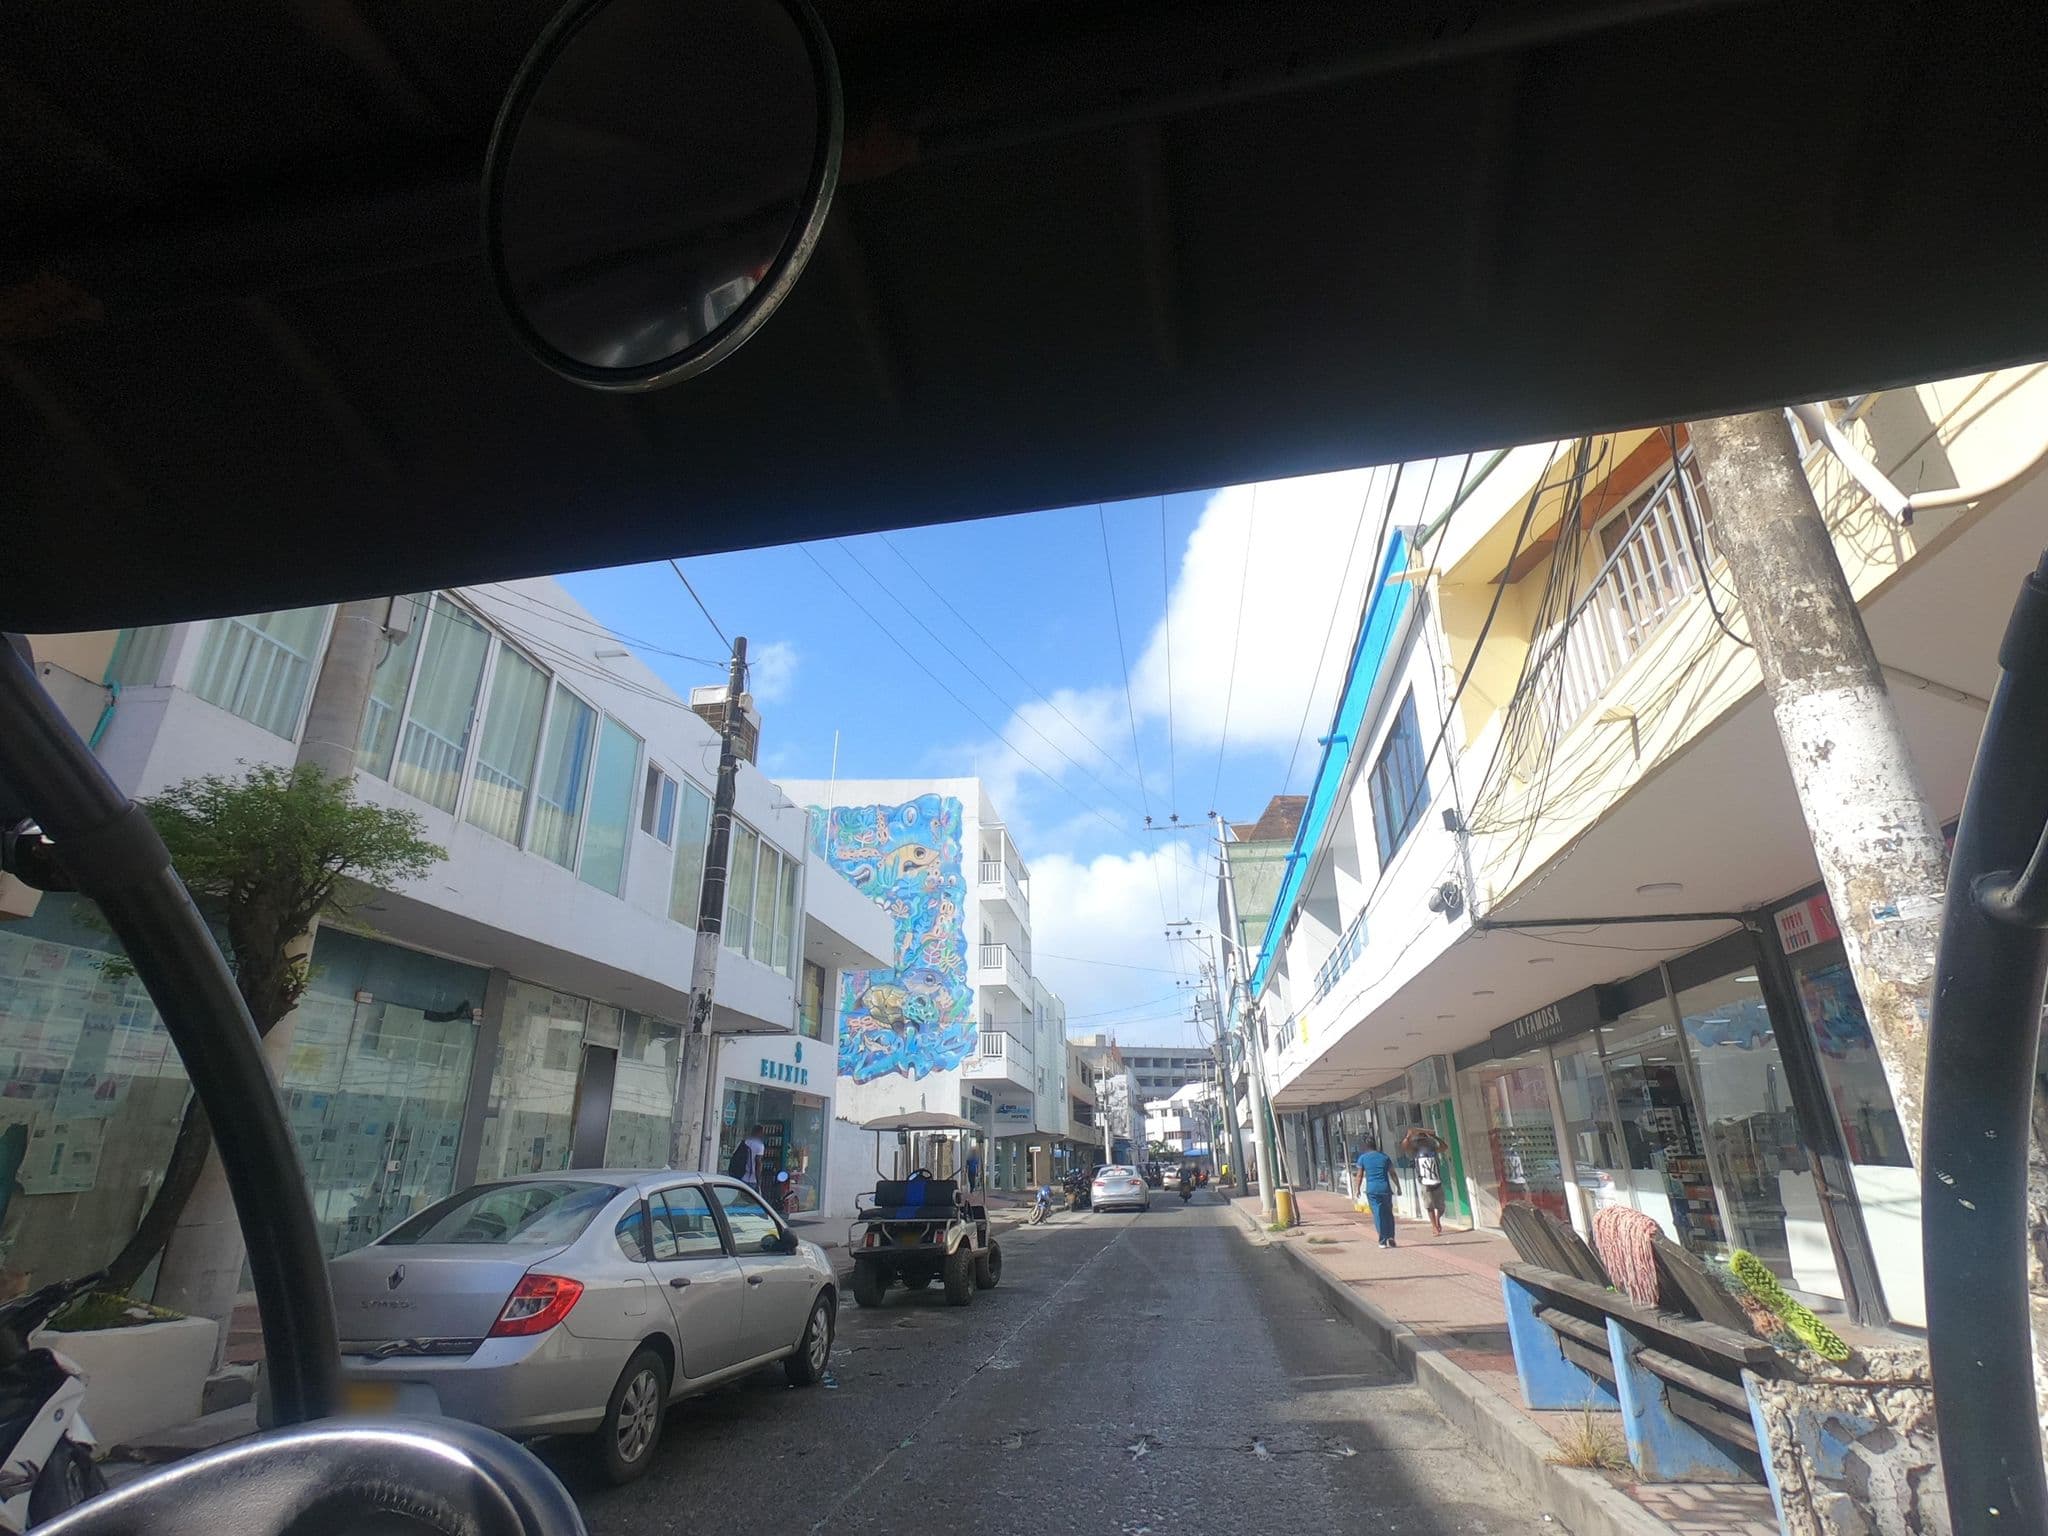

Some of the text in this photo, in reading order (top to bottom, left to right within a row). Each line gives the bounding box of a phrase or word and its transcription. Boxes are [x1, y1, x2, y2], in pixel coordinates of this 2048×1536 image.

[1514, 1019, 1526, 1039] LA
[1526, 1005, 1561, 1034] FAMOSA
[760, 1059, 808, 1086] ELIXIR
[1423, 1157, 1439, 1180] NY
